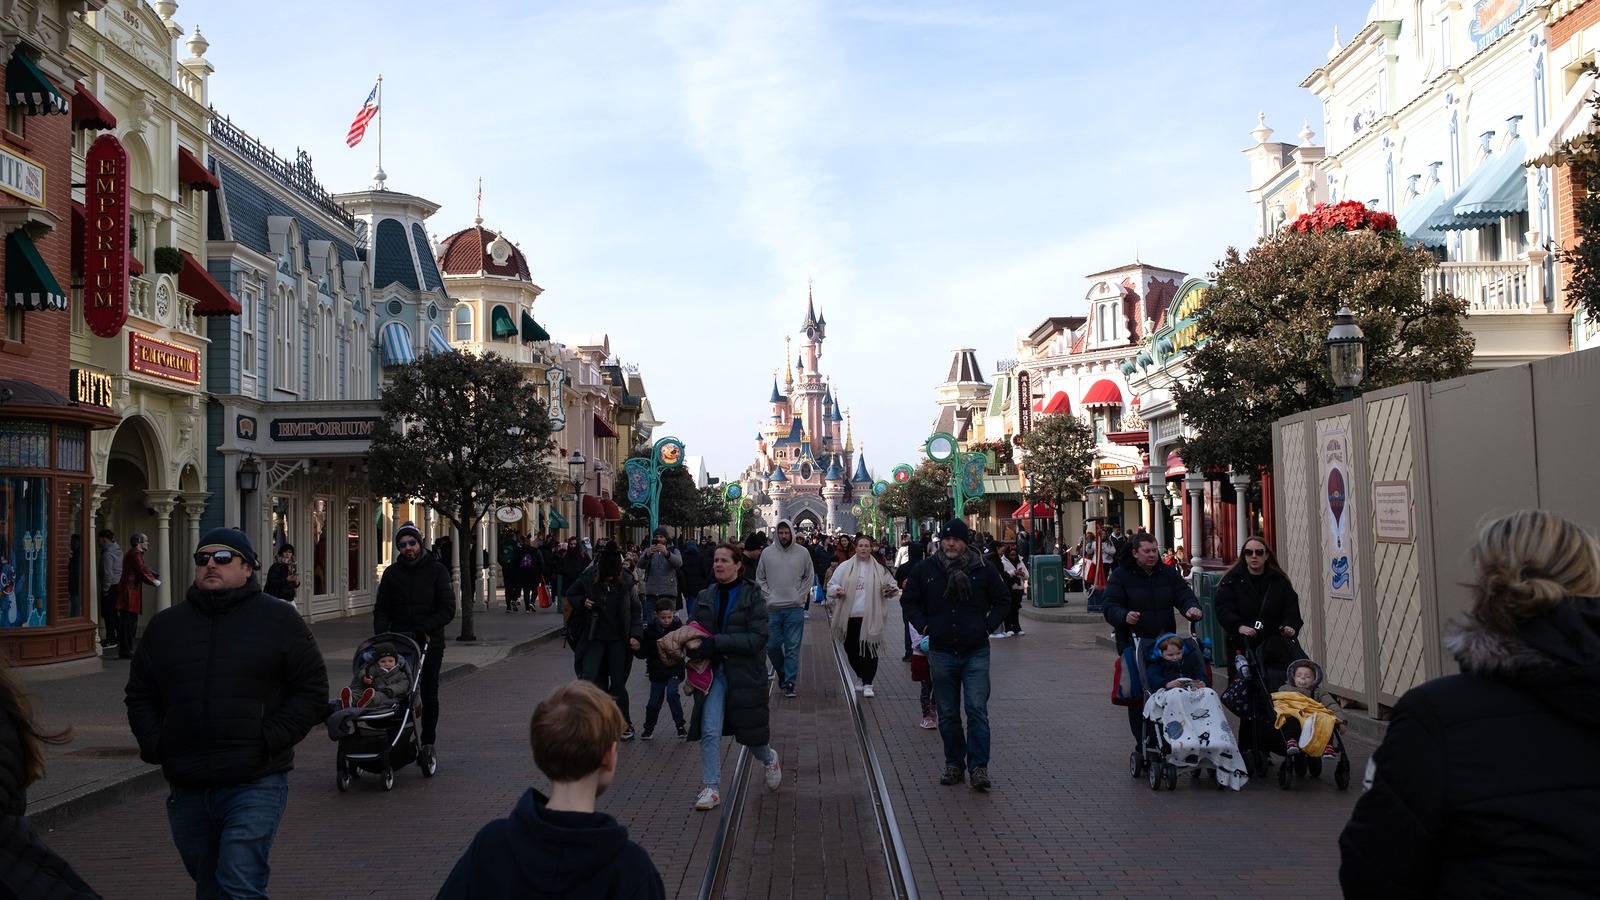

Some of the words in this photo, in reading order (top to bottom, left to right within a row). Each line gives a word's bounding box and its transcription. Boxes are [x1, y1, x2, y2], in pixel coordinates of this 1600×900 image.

[123, 10, 140, 29] 1896
[94, 159, 116, 308] EMPORIUM
[140, 345, 193, 373] EMPORIUM
[77, 368, 113, 408] GIFTS
[277, 421, 375, 437] EMPORIUM
